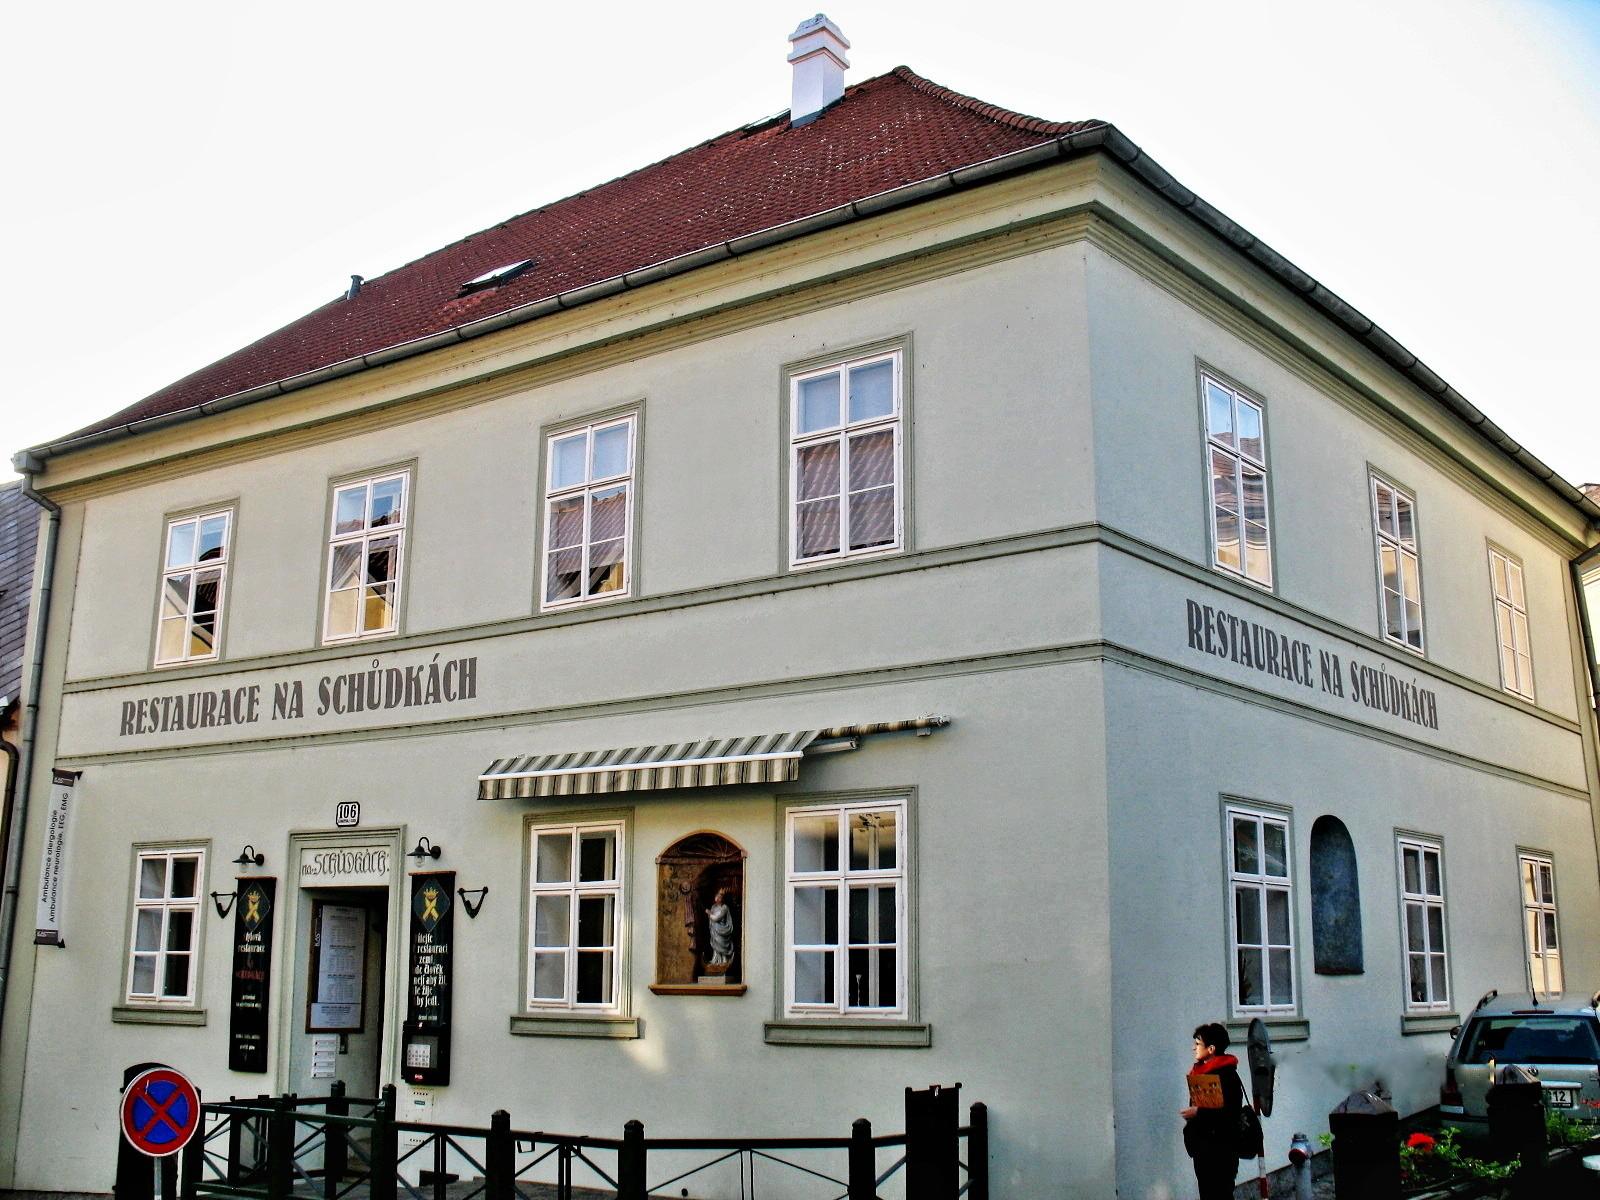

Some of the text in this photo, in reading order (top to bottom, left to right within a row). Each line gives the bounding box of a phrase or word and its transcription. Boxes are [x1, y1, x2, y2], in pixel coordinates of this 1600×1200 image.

[119, 652, 478, 737] RESTAURACE NA SCHŮDKÁCH
[1186, 598, 1439, 730] RESTAURACE NA SCHŮDKÁCH
[41, 809, 58, 903] Ambulance alergologie
[49, 876, 58, 923] Ambulance
[60, 792, 69, 811] EMG
[339, 804, 357, 819] 106
